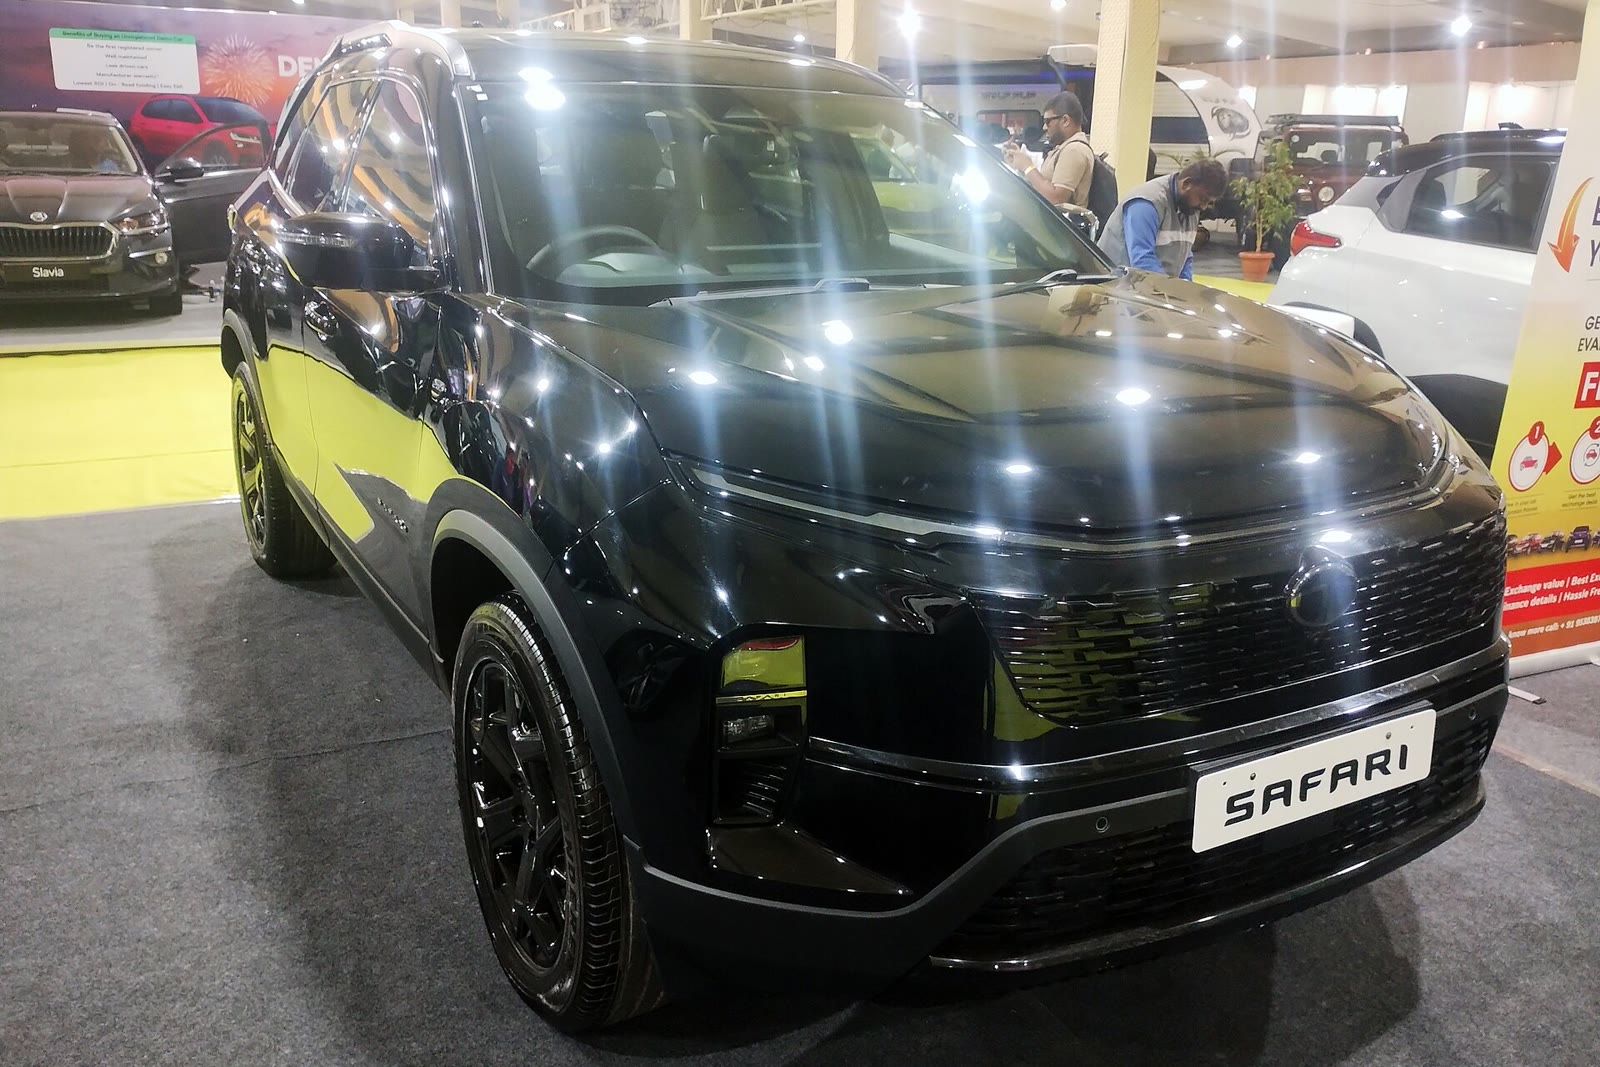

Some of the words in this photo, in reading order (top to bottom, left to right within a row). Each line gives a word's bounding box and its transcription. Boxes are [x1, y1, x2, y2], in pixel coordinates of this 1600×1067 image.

[1590, 239, 1600, 268] Y
[32, 266, 65, 278] Slavia
[1578, 336, 1600, 352] EVA
[1534, 425, 1540, 440] 1
[1504, 582, 1542, 597] Exchange
[1543, 578, 1565, 590] value
[1570, 574, 1589, 586] Best
[1530, 593, 1557, 607] details
[1563, 588, 1589, 602] Hassle
[1527, 626, 1544, 636] more
[1224, 744, 1408, 827] SAFARI
